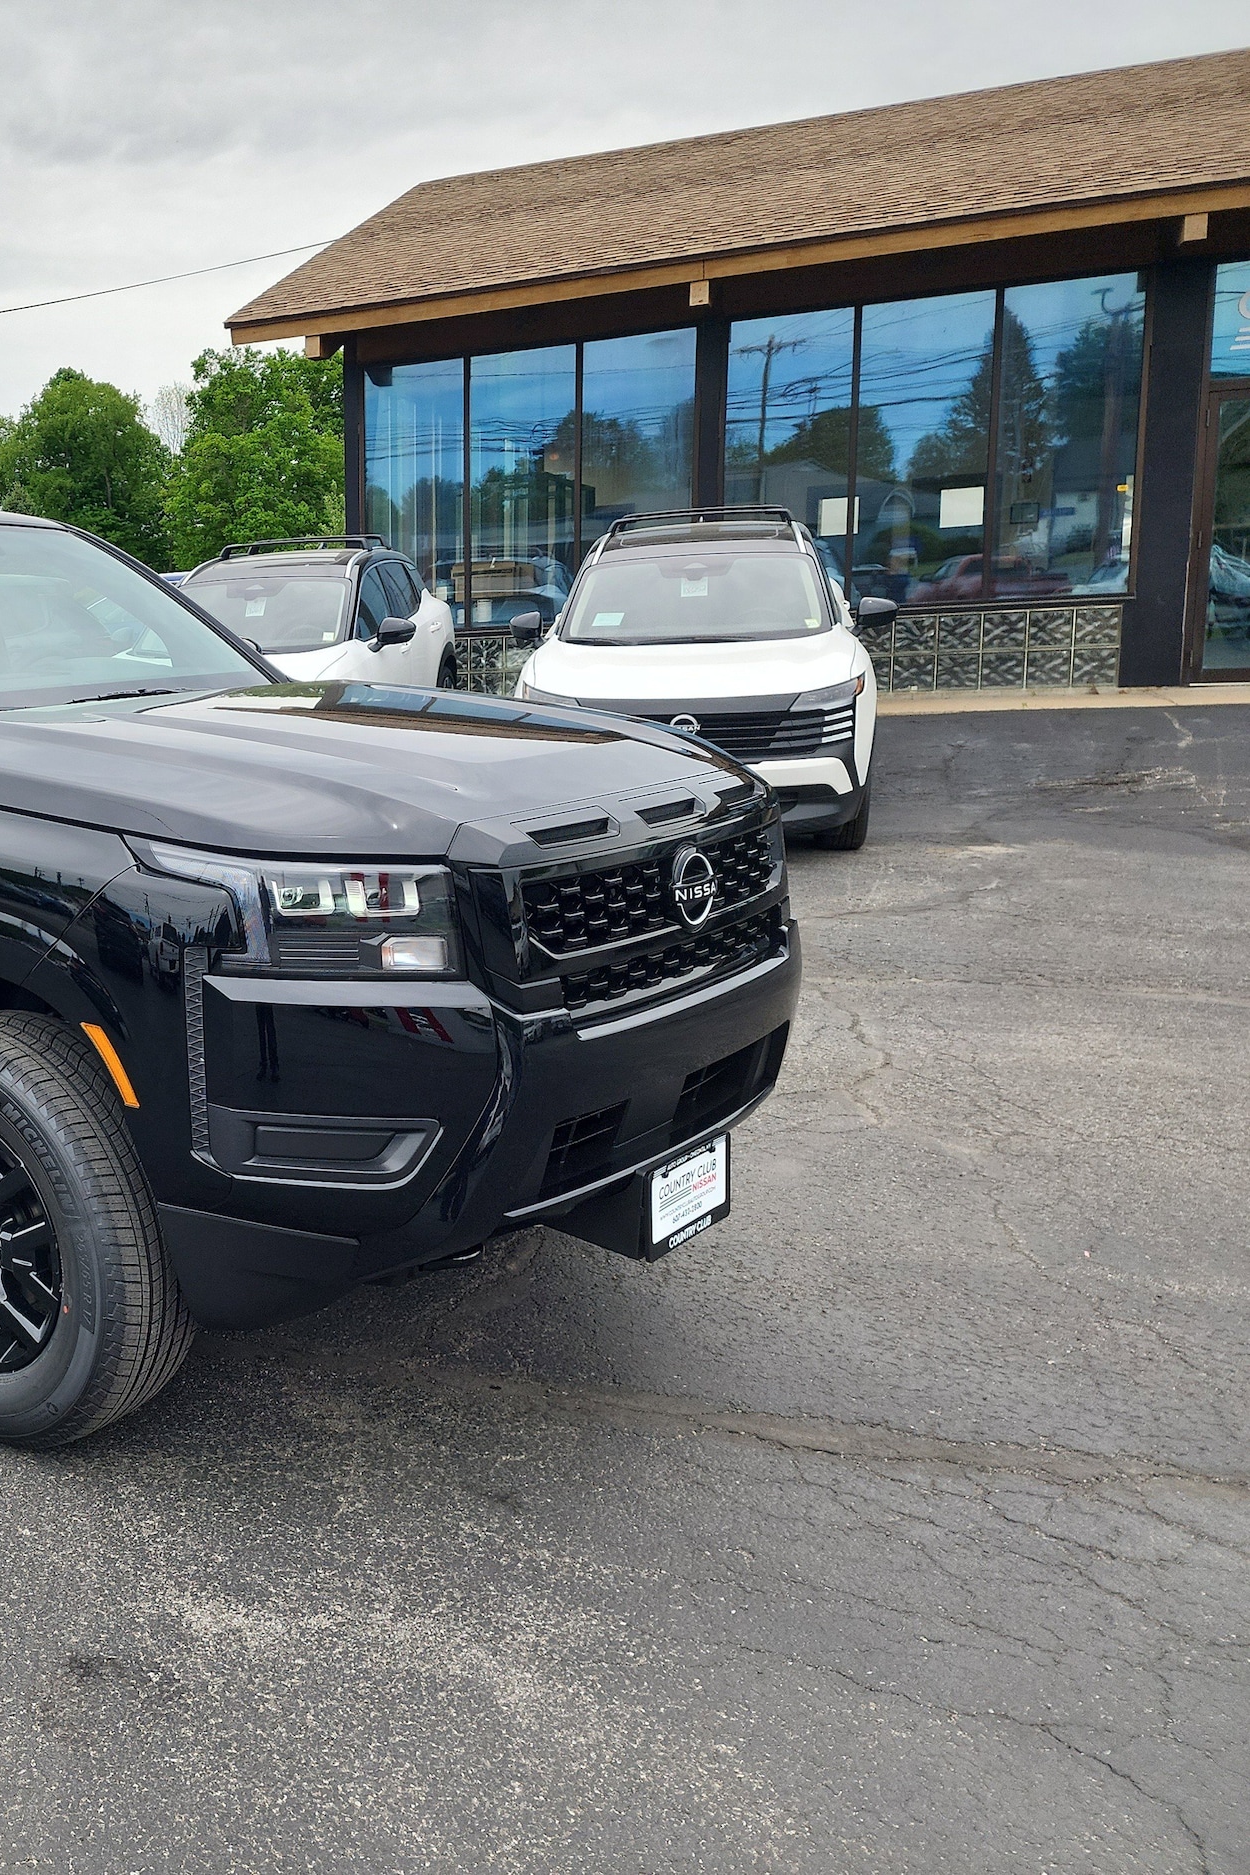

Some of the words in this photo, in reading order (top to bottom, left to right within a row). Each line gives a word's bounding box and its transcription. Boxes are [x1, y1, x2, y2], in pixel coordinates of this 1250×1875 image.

[675, 881, 716, 901] NISSA
[1, 1102, 75, 1211] MICHELIN
[658, 1170, 696, 1200] COUNTRY
[697, 1158, 717, 1178] CLUB
[692, 1172, 717, 1192] NISSAN
[668, 1222, 698, 1249] COUNTRY
[696, 1214, 712, 1232] CLUB
